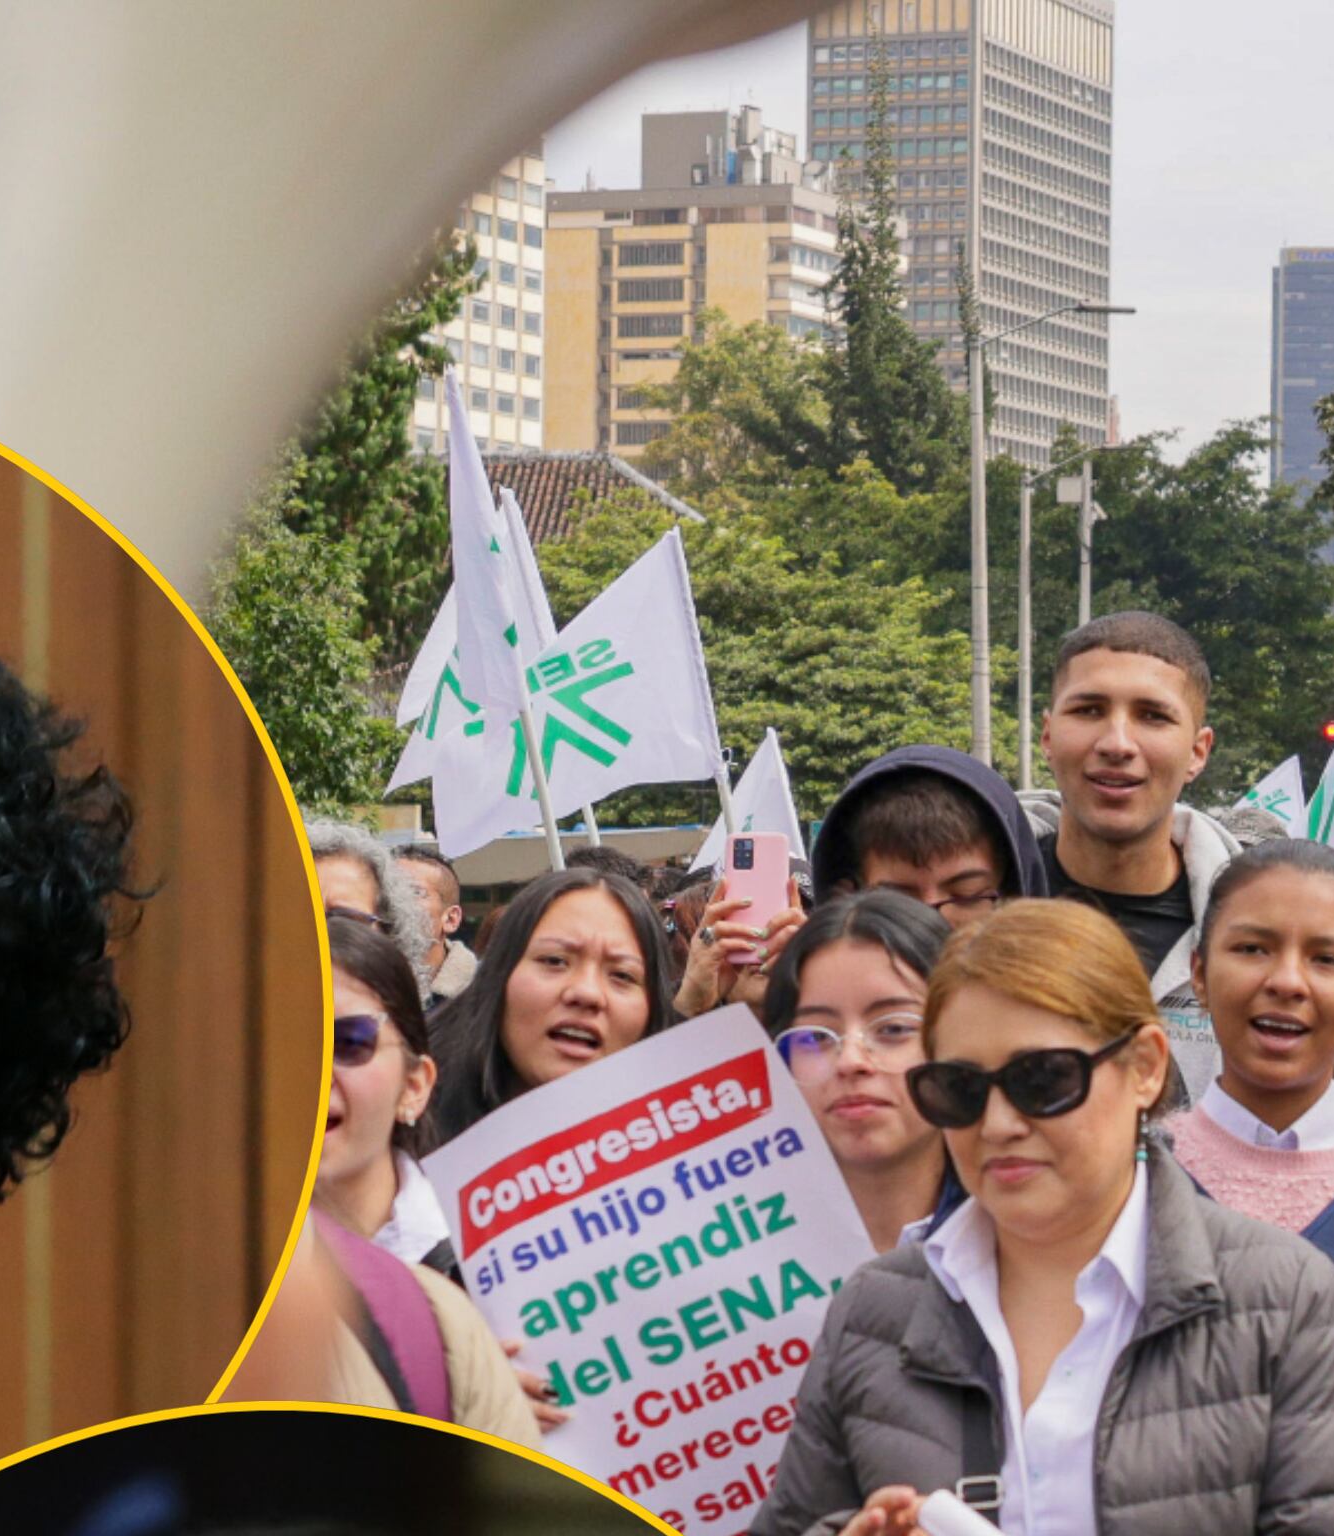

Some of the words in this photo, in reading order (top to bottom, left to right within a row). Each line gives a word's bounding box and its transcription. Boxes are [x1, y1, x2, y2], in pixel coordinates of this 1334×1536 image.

[467, 1077, 763, 1230] Congresista,
[476, 1247, 505, 1296] si
[511, 1227, 569, 1272] su
[571, 1186, 667, 1245] hijo
[672, 1126, 805, 1201] fuera
[518, 1190, 797, 1340] aprendiz
[607, 1396, 798, 1496] merece
[612, 1336, 812, 1448] ¿Cuánto
